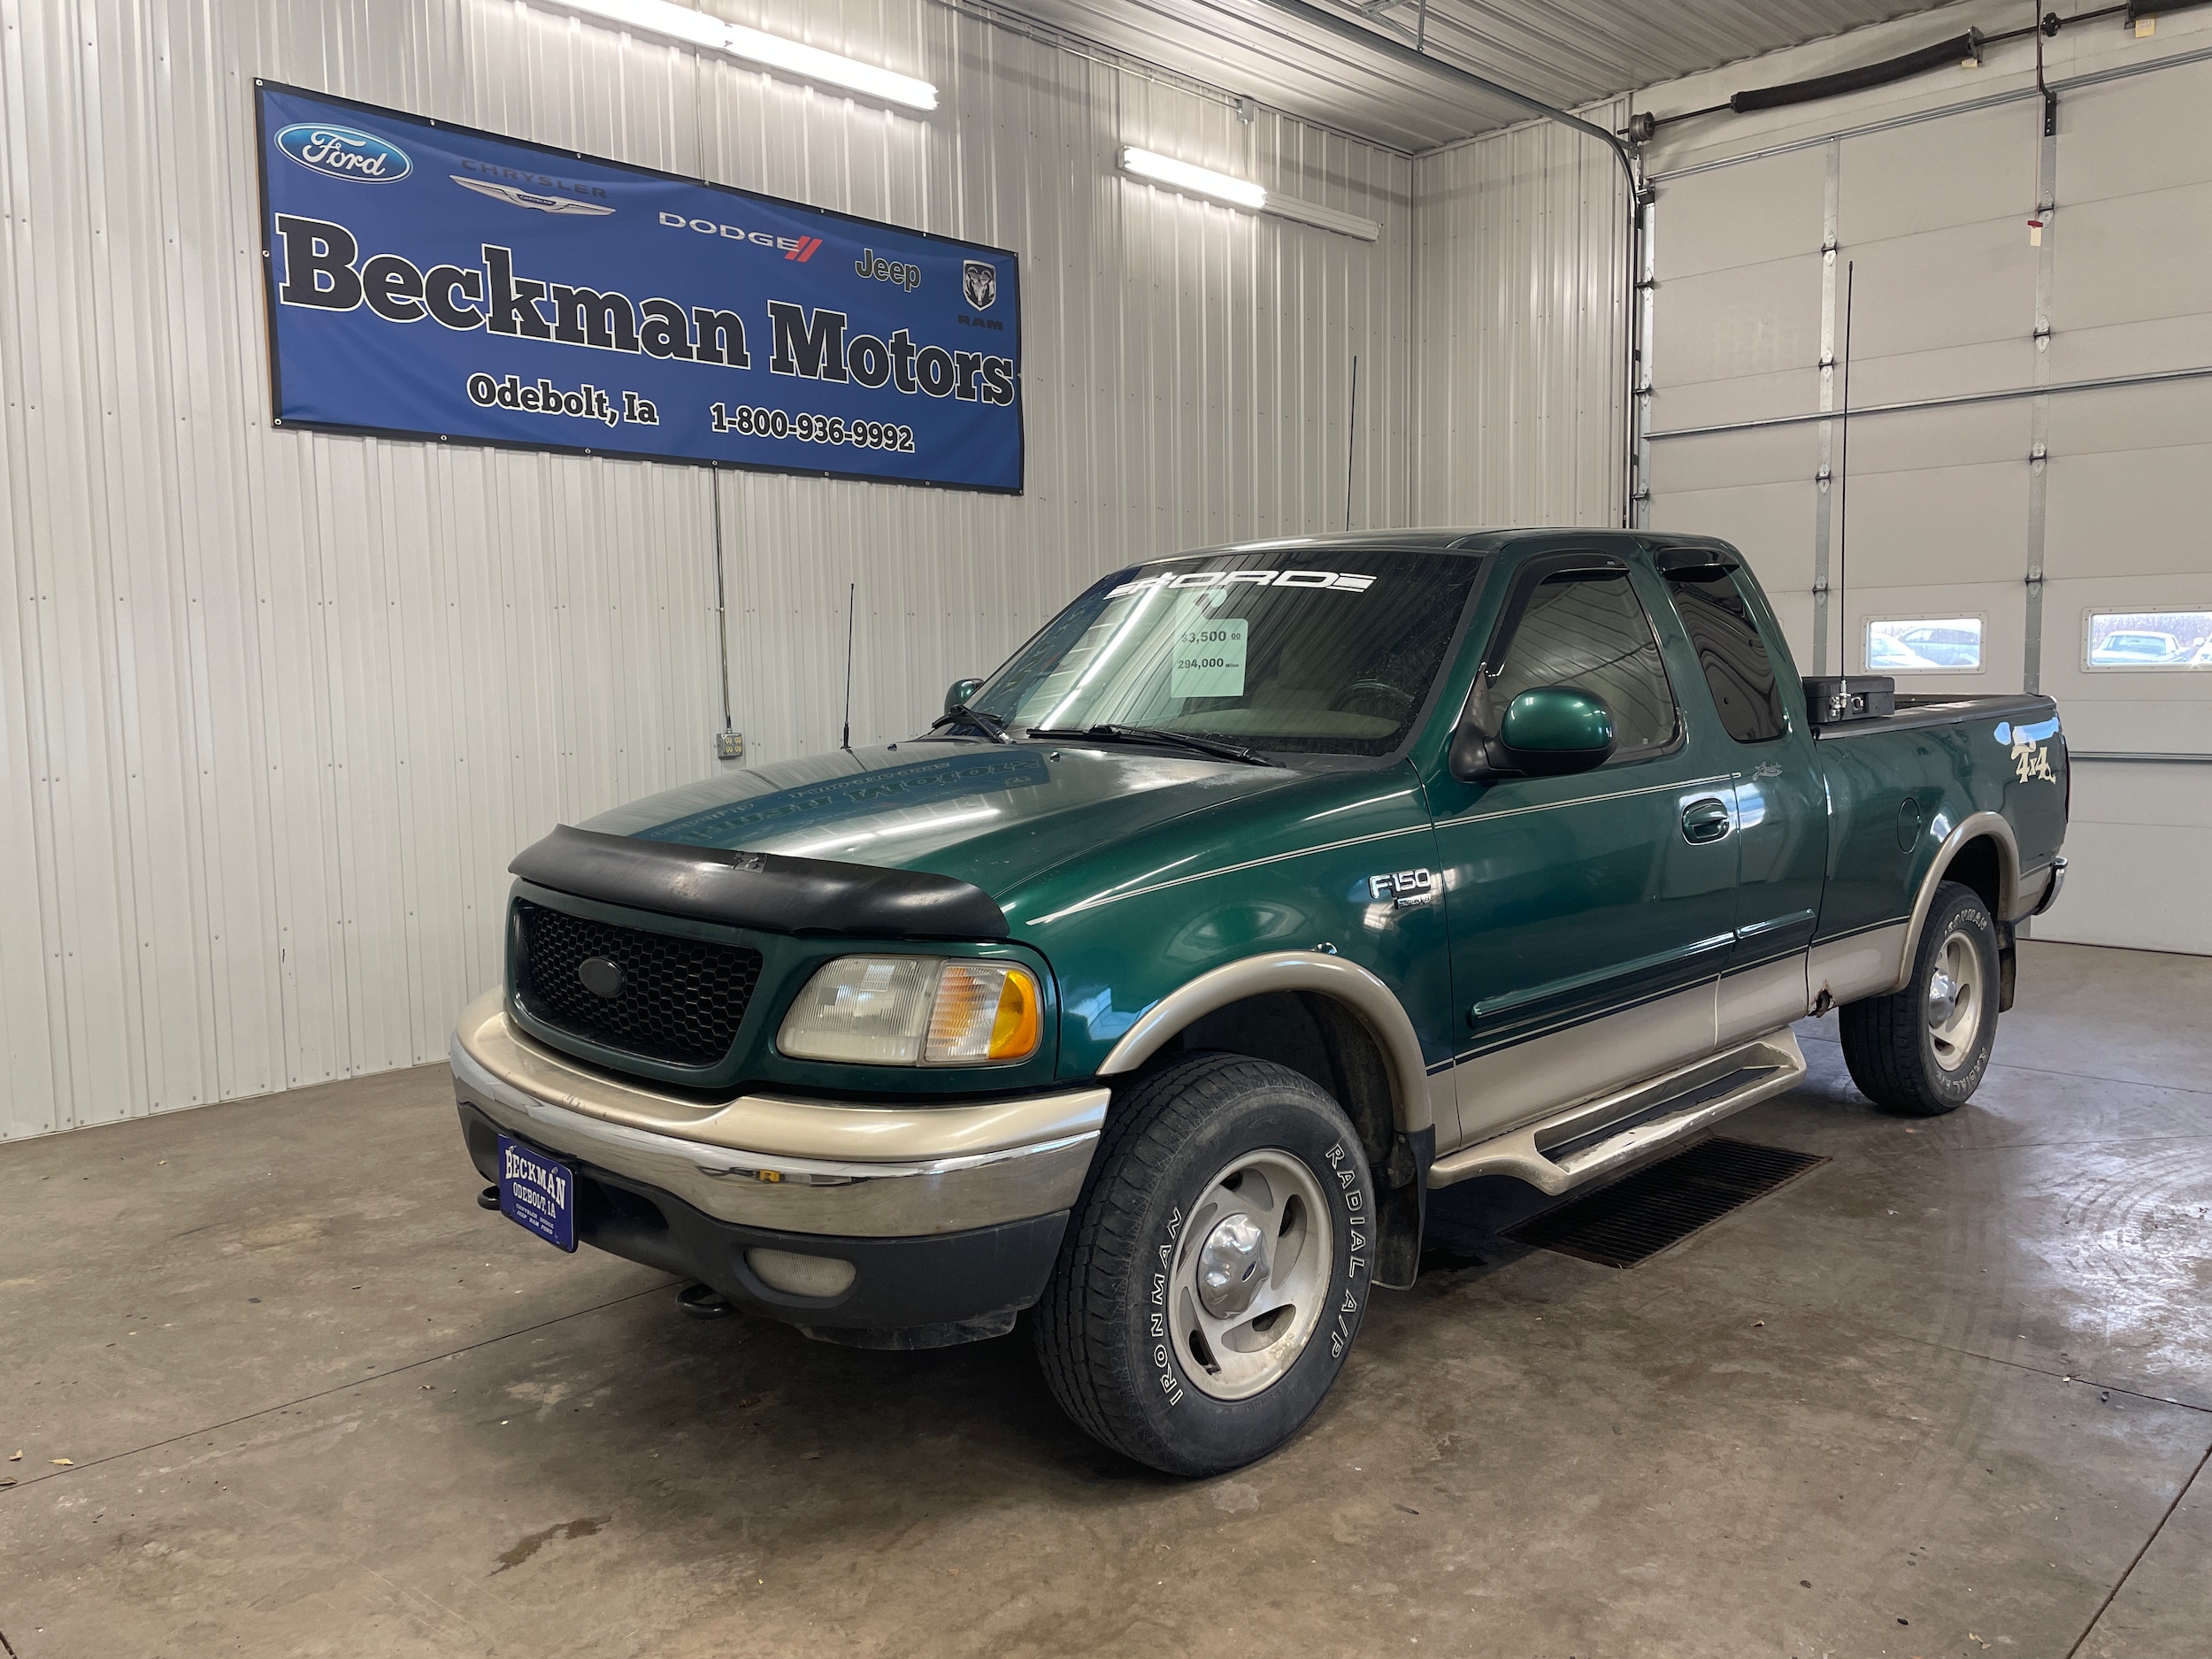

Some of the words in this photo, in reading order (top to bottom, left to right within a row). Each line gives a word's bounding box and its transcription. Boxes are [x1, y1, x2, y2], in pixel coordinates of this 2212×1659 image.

[302, 130, 388, 178] Ford
[461, 159, 607, 199] CHRYSLER
[658, 211, 801, 251] DODGE
[855, 249, 921, 293] Jeep
[275, 212, 750, 370] Beckman
[767, 299, 1014, 406] Motors
[957, 314, 1003, 331] RAM
[466, 372, 618, 426] Odebolt,
[621, 391, 659, 426] Ia
[710, 403, 915, 453] 1-800-936-9992
[1178, 658, 1224, 670] 294,000
[2016, 746, 2056, 785] 4x4
[505, 1149, 566, 1210] BECKMAN
[513, 1182, 547, 1215] ODEBOLT,
[548, 1200, 557, 1219] IA
[1325, 1143, 1365, 1279] RADIAL
[1150, 1206, 1184, 1405] IRONMAN
[1331, 1289, 1357, 1359] A/P
